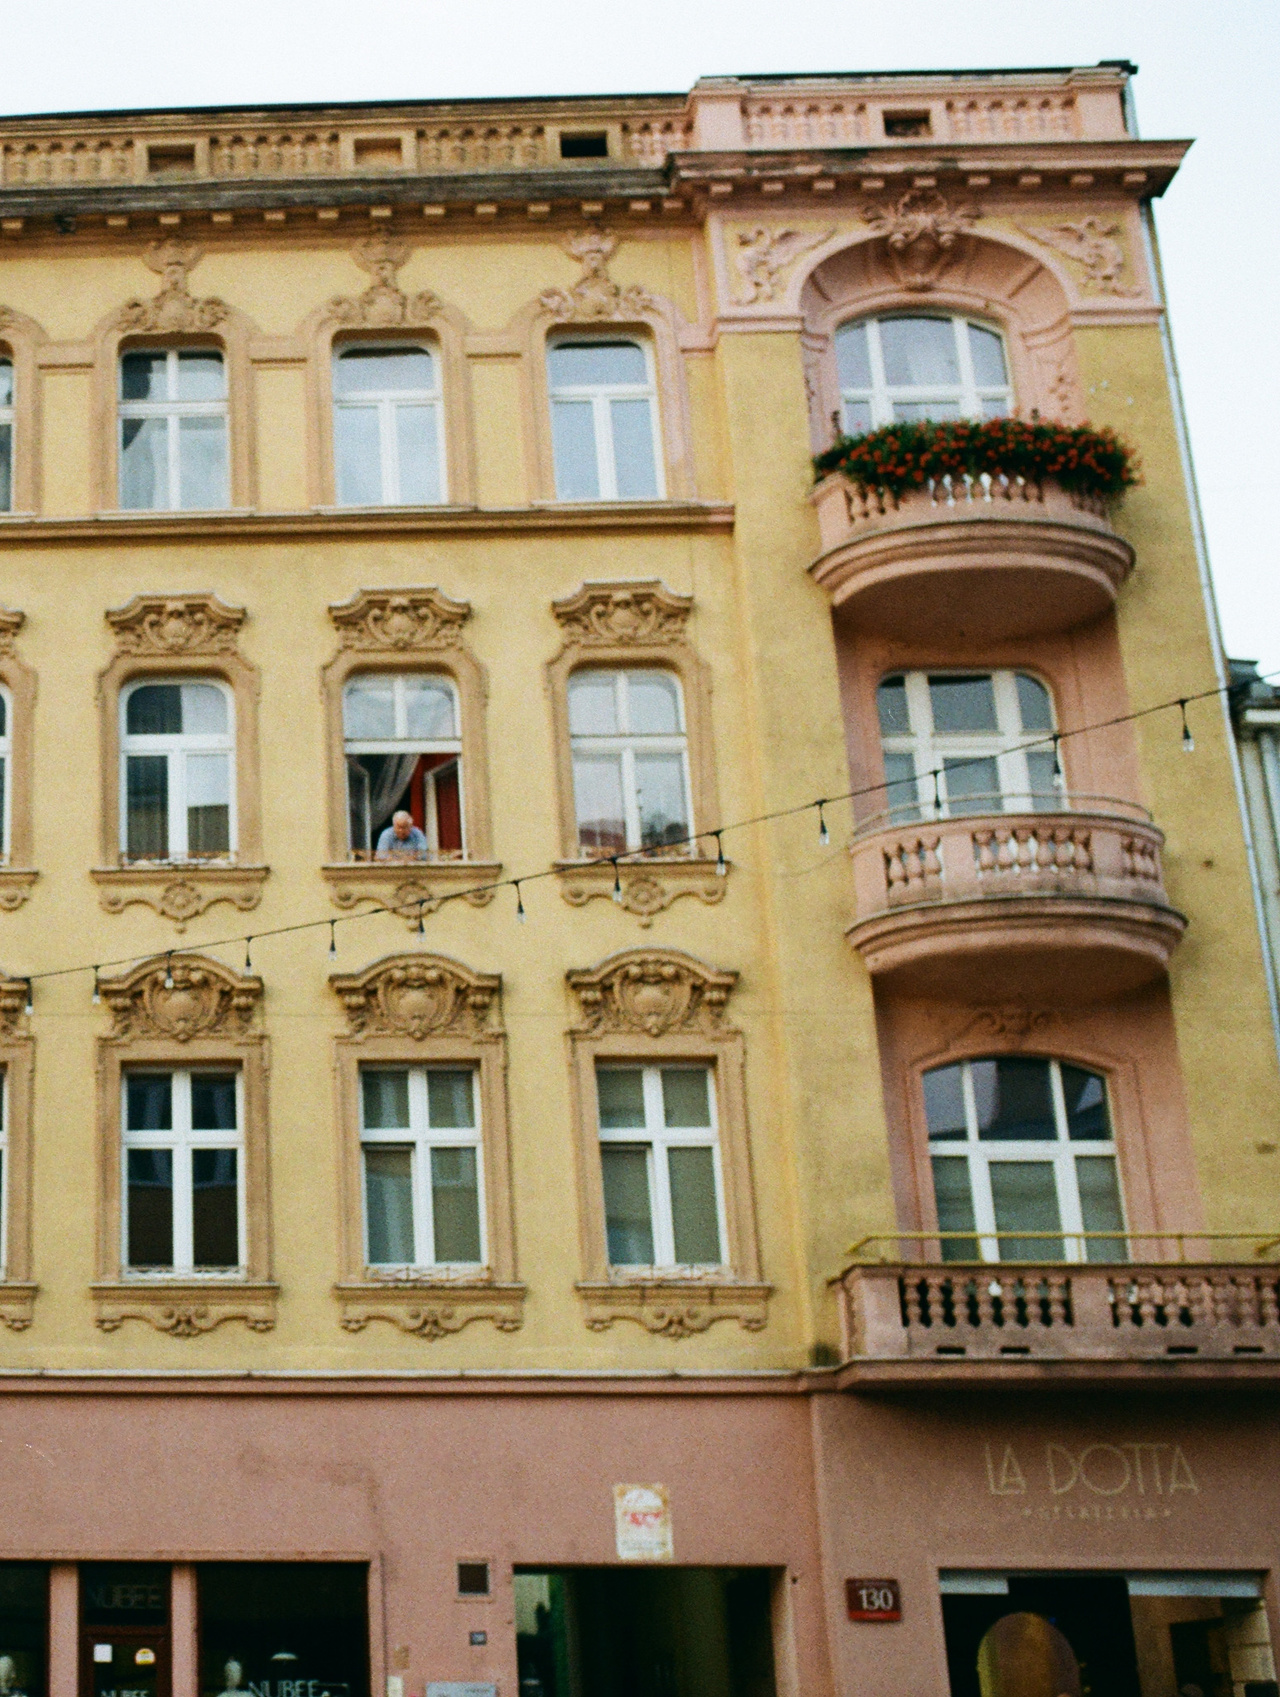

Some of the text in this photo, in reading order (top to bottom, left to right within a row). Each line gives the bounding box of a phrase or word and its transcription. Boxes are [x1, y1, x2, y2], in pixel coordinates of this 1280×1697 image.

[984, 1443, 1201, 1496] LA DOTTA
[858, 1588, 894, 1610] 130
